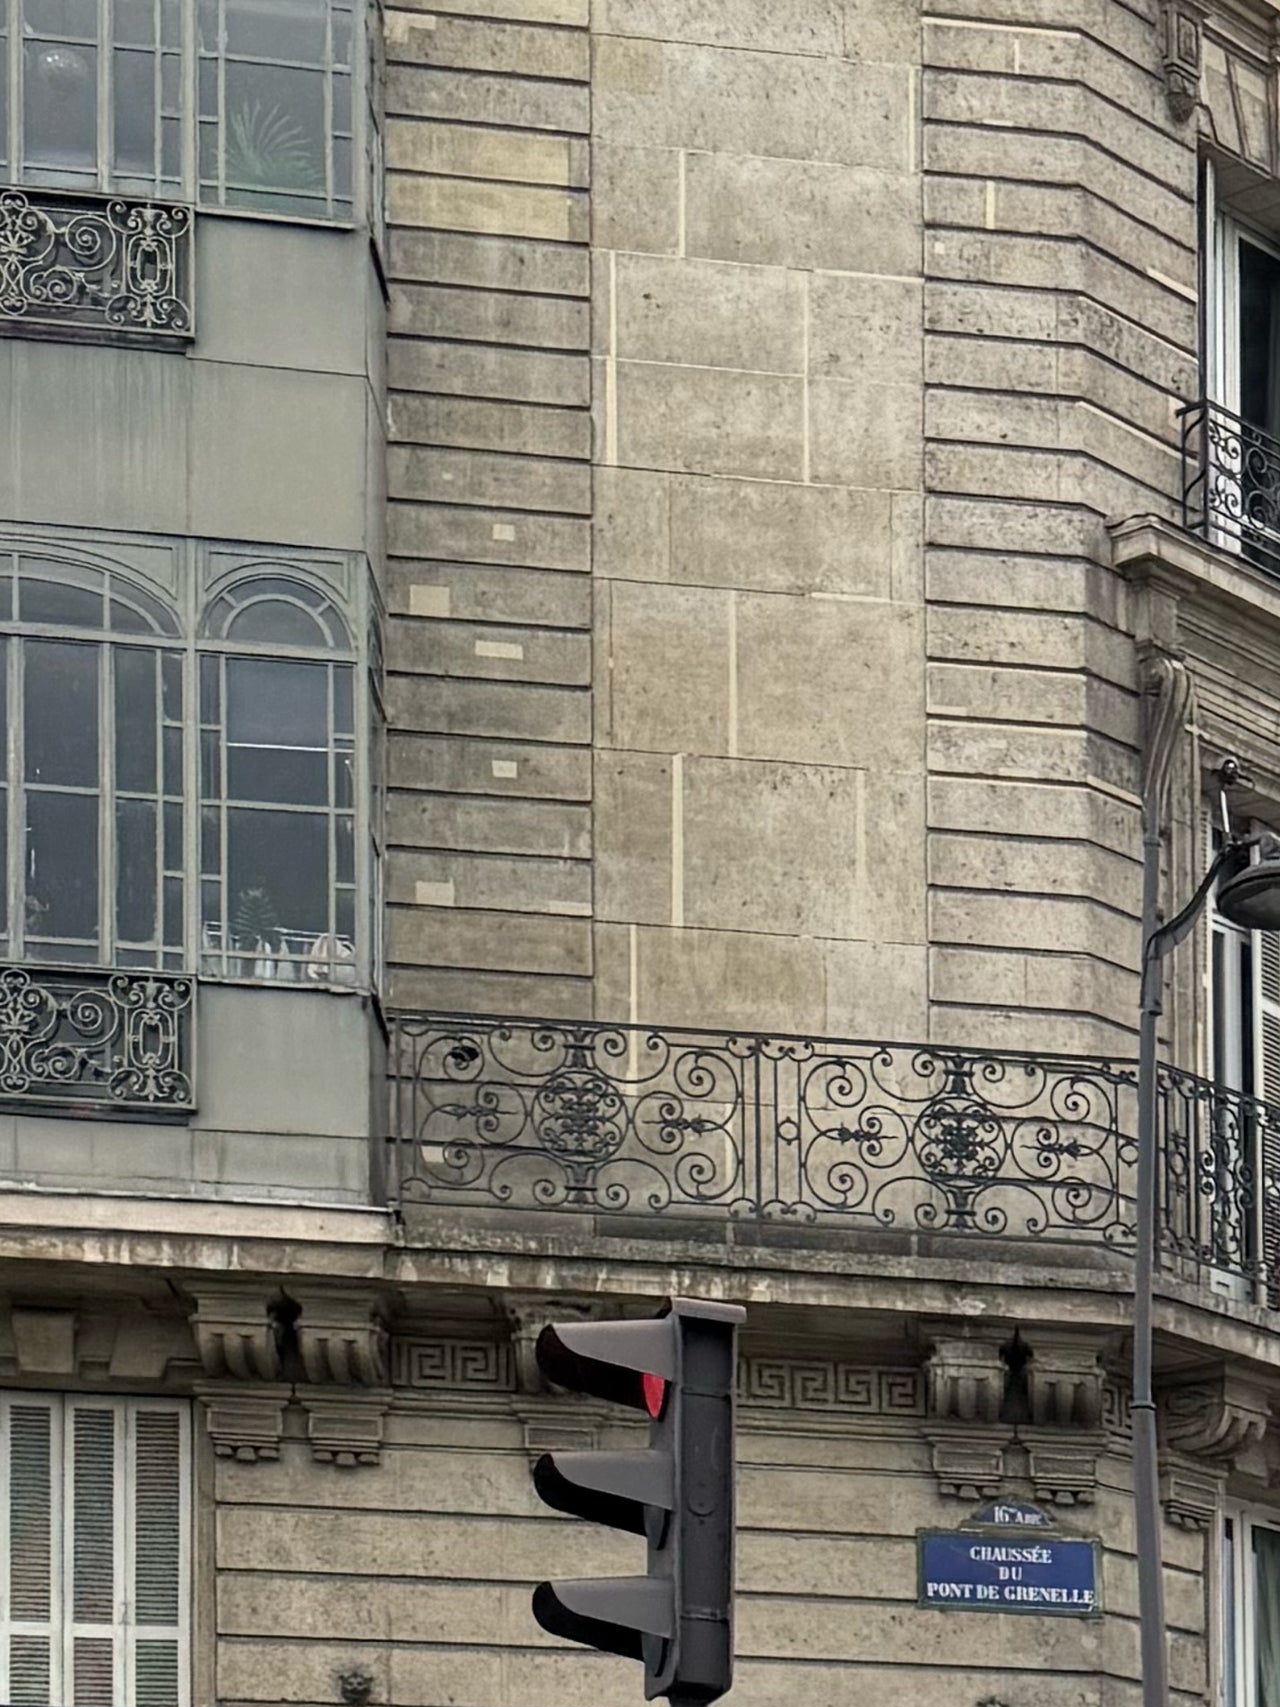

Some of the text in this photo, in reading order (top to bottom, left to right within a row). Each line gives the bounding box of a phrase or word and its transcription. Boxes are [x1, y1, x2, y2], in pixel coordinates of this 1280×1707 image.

[970, 1546, 1052, 1563] CHAUSSÉE
[999, 1566, 1023, 1581] DU
[927, 1582, 1094, 1604] PONT DE GRENELLE
